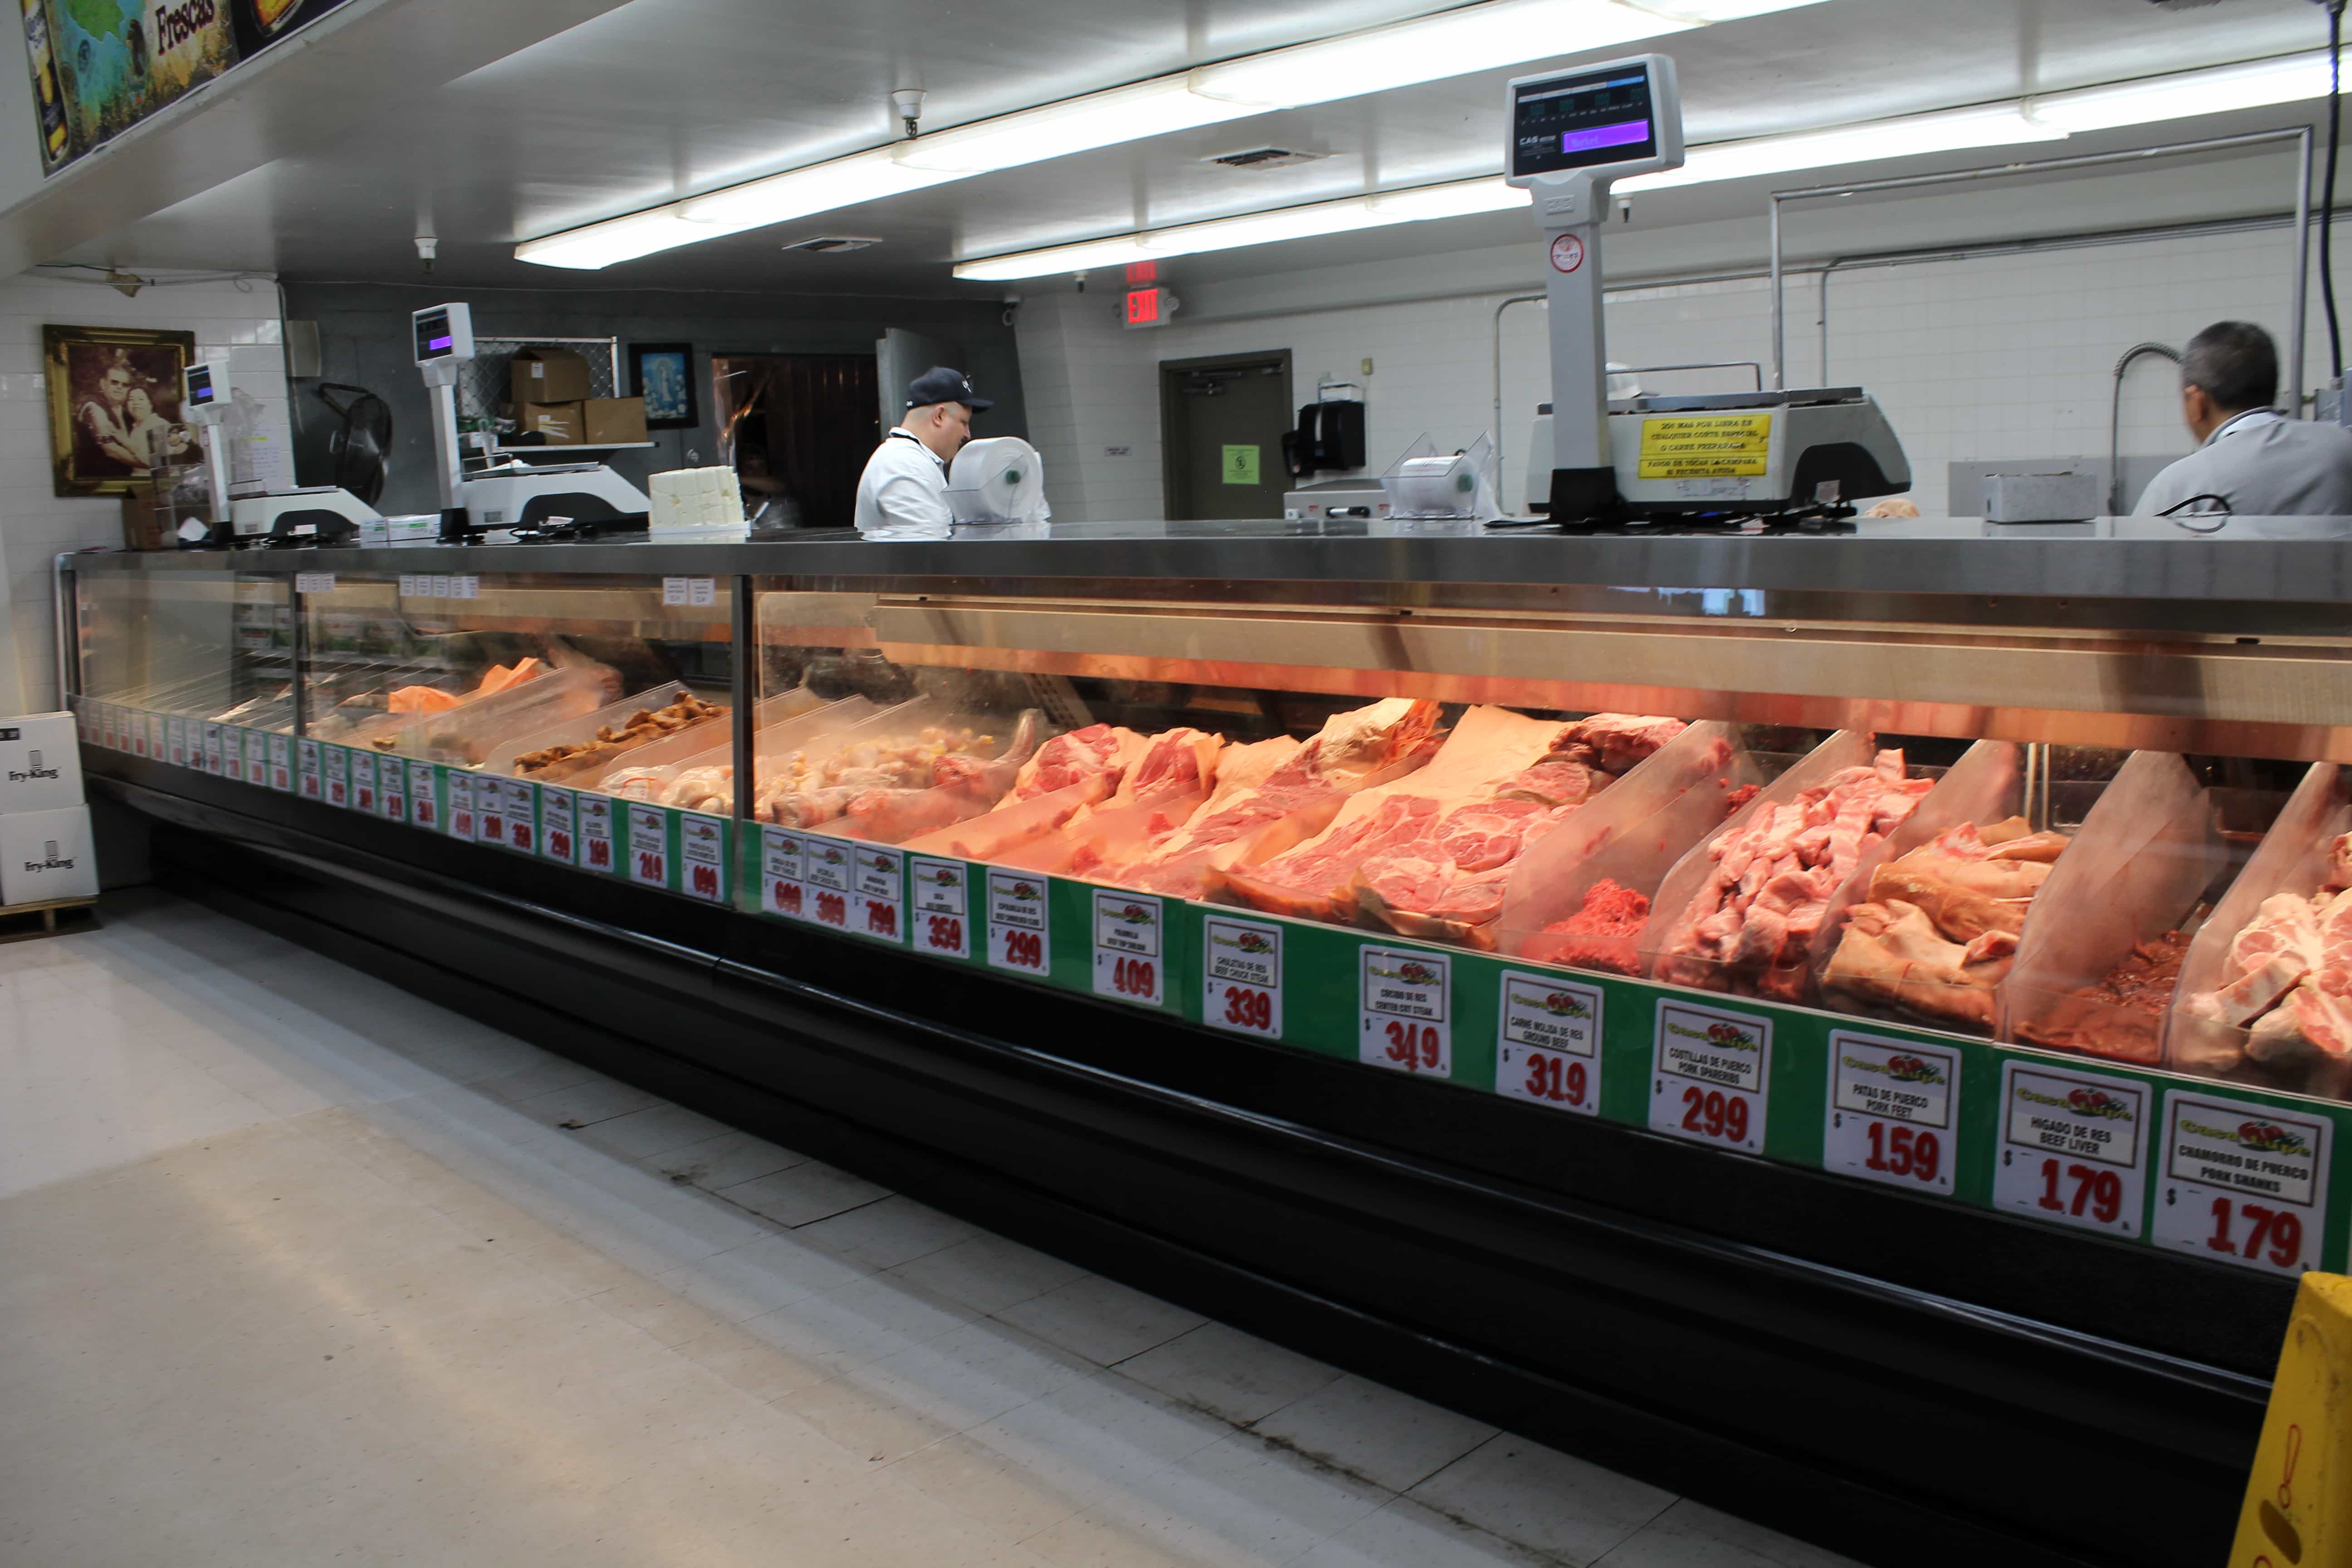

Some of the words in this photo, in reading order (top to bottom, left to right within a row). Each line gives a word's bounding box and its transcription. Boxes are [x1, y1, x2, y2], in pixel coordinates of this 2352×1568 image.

[155, 0, 214, 56] Frescas
[1519, 136, 1539, 146] CAS
[1127, 289, 1159, 323] EXIT
[9, 769, 59, 783] Fry-King
[24, 859, 74, 873] Fry-King
[928, 915, 961, 951] 359
[1004, 930, 1041, 969] 299
[1113, 956, 1155, 998] 409
[1225, 986, 1271, 1031] 339
[1510, 1016, 1533, 1029] CARNE
[1534, 1021, 1558, 1034] MOLIDA
[1560, 1026, 1569, 1037] DE
[1570, 1029, 1583, 1040] RES
[1523, 1030, 1550, 1045] GROUND
[1552, 1036, 1569, 1049] BEEF
[1385, 1020, 1439, 1072] 349
[1669, 1047, 1707, 1064] COSTILLAS
[1710, 1056, 1720, 1067] DE
[1721, 1058, 1752, 1074] PUERCO
[1525, 1053, 1587, 1106] 319
[1678, 1061, 1699, 1074] PORK
[1700, 1066, 1740, 1084] SPARERIBS
[1852, 1083, 1878, 1099] PATAS
[1880, 1088, 1892, 1102] DE
[1893, 1091, 1928, 1108] PUERCO
[1866, 1099, 1890, 1112] PORK
[1891, 1103, 1914, 1118] FEET
[1681, 1086, 1748, 1143] 299
[2030, 1116, 2071, 1135] HIGADO
[2073, 1125, 2088, 1138] DE
[2090, 1128, 2112, 1143] RES
[1866, 1121, 1940, 1182] 159
[2039, 1132, 2066, 1147] BEEF
[2068, 1138, 2100, 1155] LIVER
[2179, 1144, 2243, 1167] CHAMORRO
[2244, 1158, 2260, 1172] DE
[2261, 1160, 2309, 1181] PUERCO
[2200, 1166, 2233, 1183] PORK
[2234, 1173, 2282, 1193] SHANKS
[2038, 1158, 2122, 1223] 179
[2207, 1197, 2303, 1268] 179
